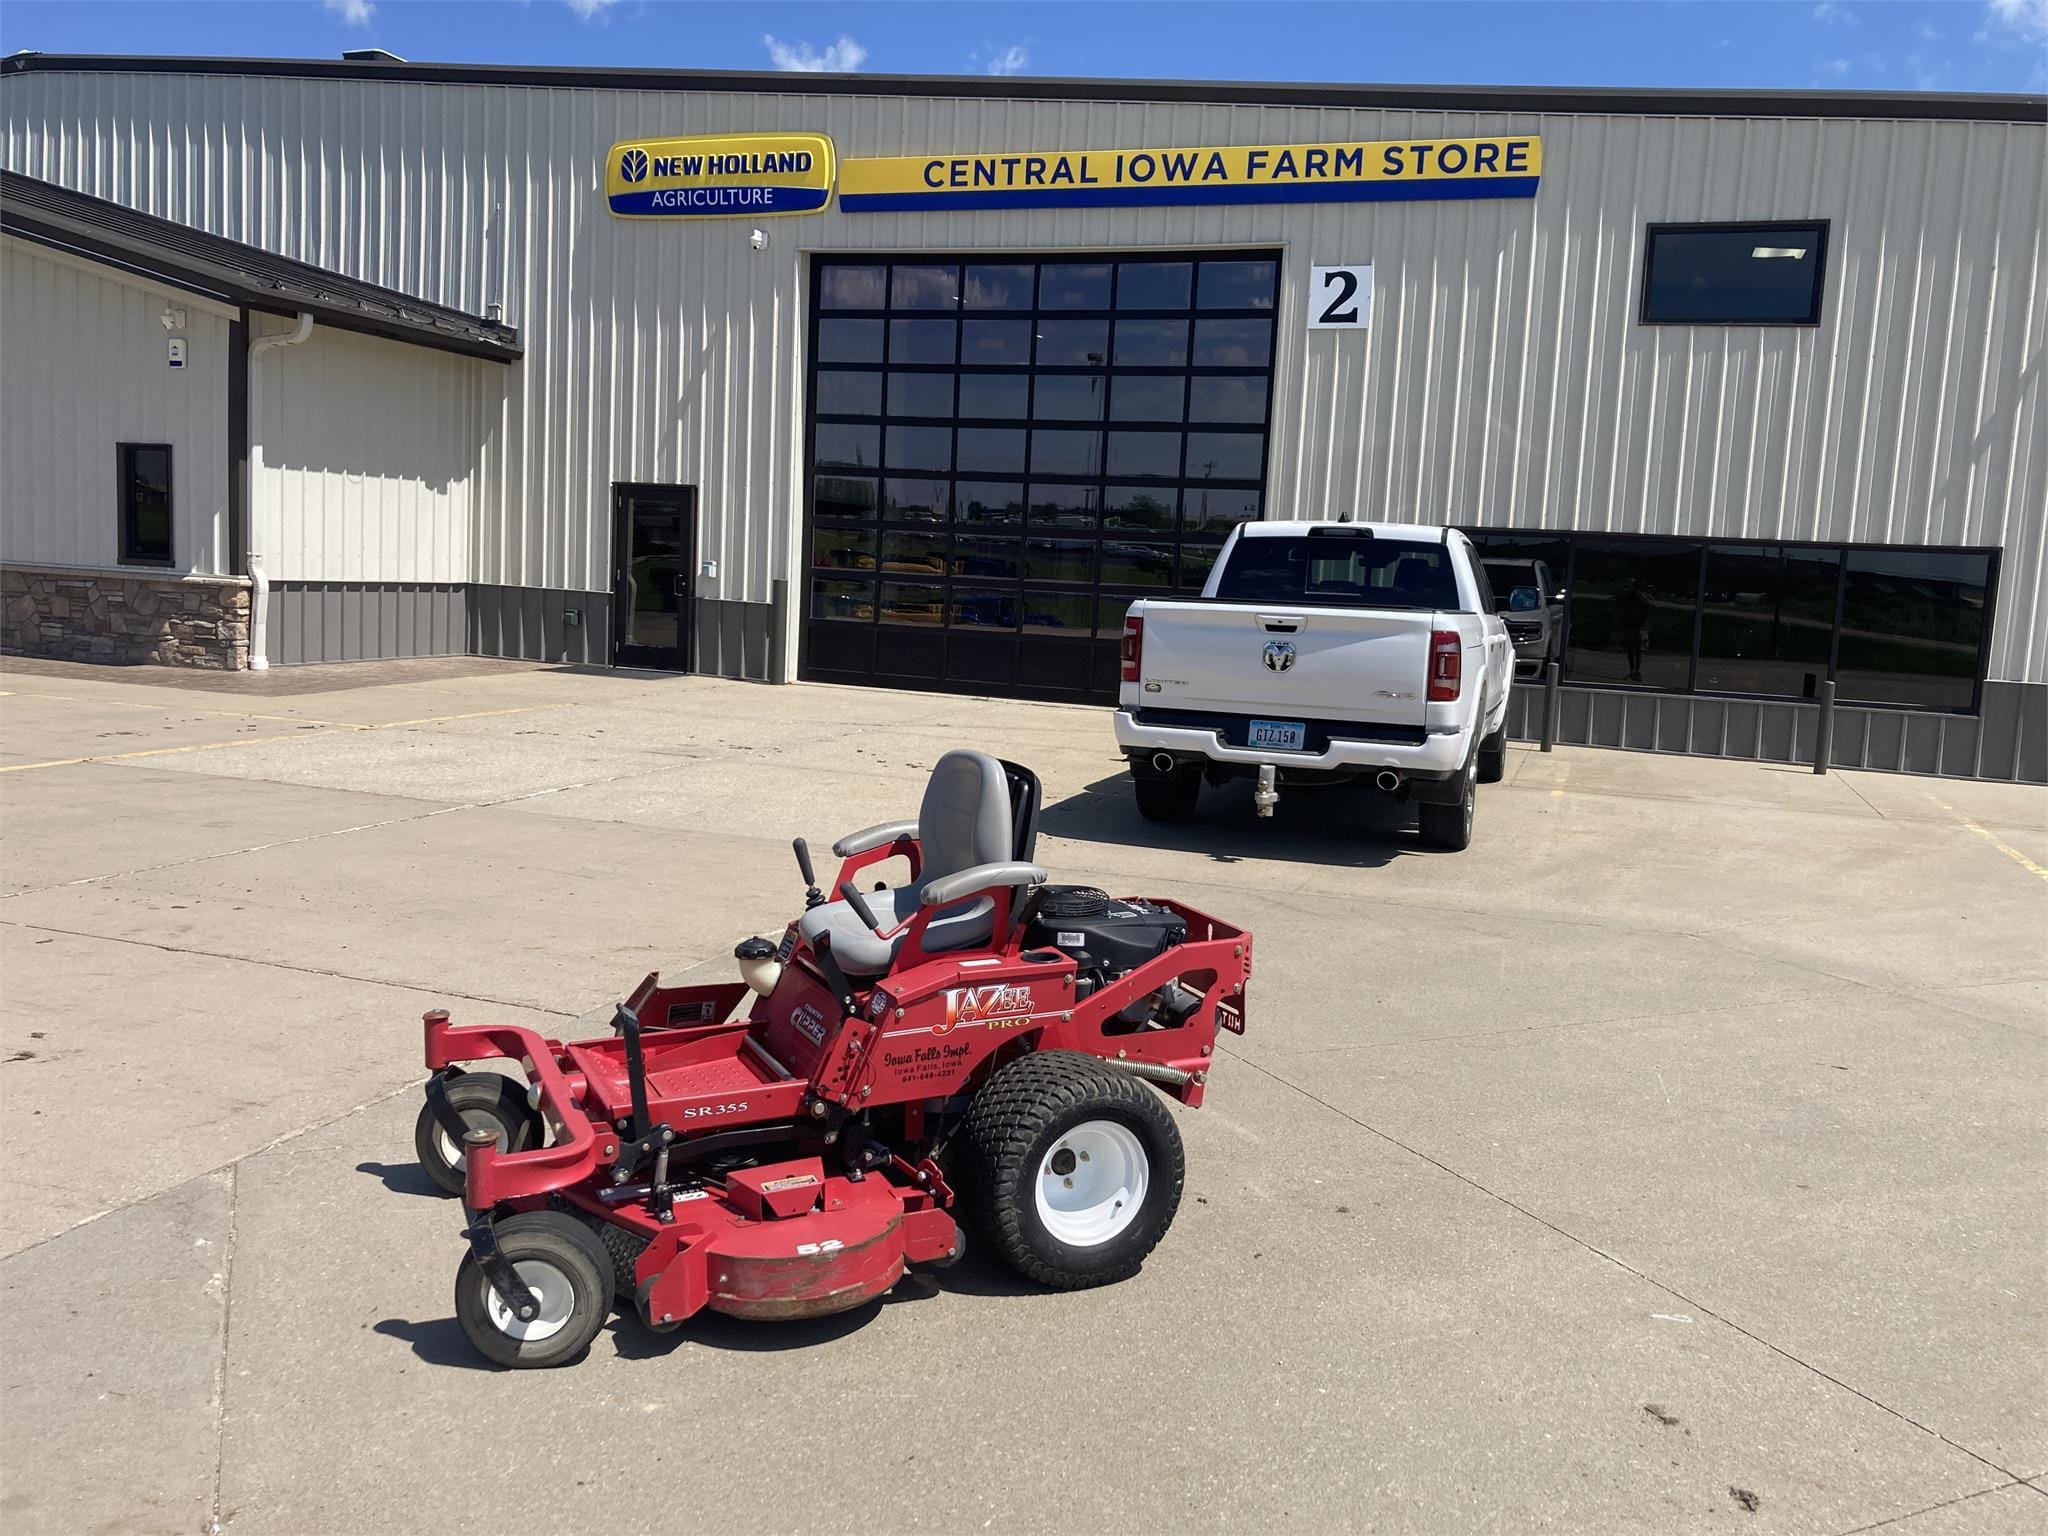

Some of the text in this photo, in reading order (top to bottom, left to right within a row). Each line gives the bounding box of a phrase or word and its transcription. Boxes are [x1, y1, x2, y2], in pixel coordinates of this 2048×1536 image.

[653, 151, 813, 177] NEW HOLLAND
[923, 141, 1531, 188] CENTRAL IOWA FARM STORE
[651, 187, 774, 208] AGRICULTURE
[1318, 270, 1359, 324] 2
[1256, 728, 1275, 743] GTZ
[790, 1007, 827, 1044] CLIPPER
[986, 1017, 1031, 1030] PRO
[884, 1042, 973, 1067] Iowa Falls Impl.
[894, 1067, 915, 1076] Iowa
[942, 1060, 963, 1069] Iowa
[796, 1239, 845, 1256] 52
